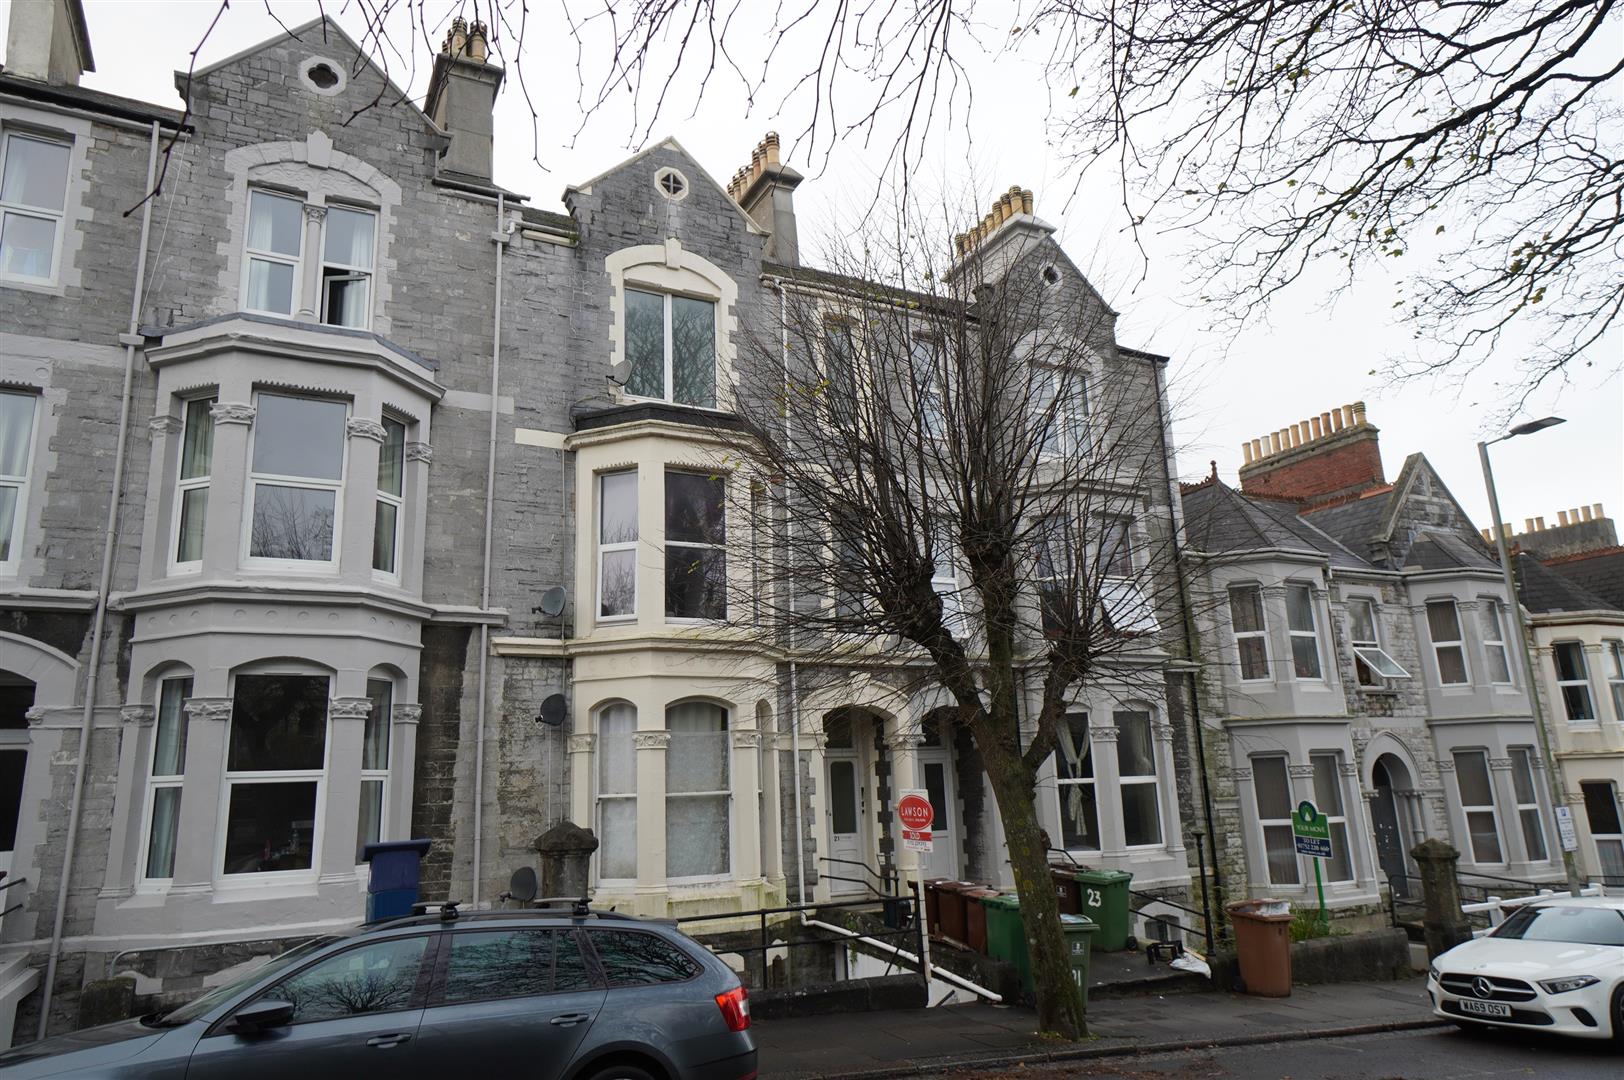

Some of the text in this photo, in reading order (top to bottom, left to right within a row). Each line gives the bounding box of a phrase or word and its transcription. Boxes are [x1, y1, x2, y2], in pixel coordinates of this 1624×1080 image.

[901, 807, 928, 817] LAWSON
[1087, 888, 1102, 907] 23
[1463, 1000, 1486, 1013] WA69
